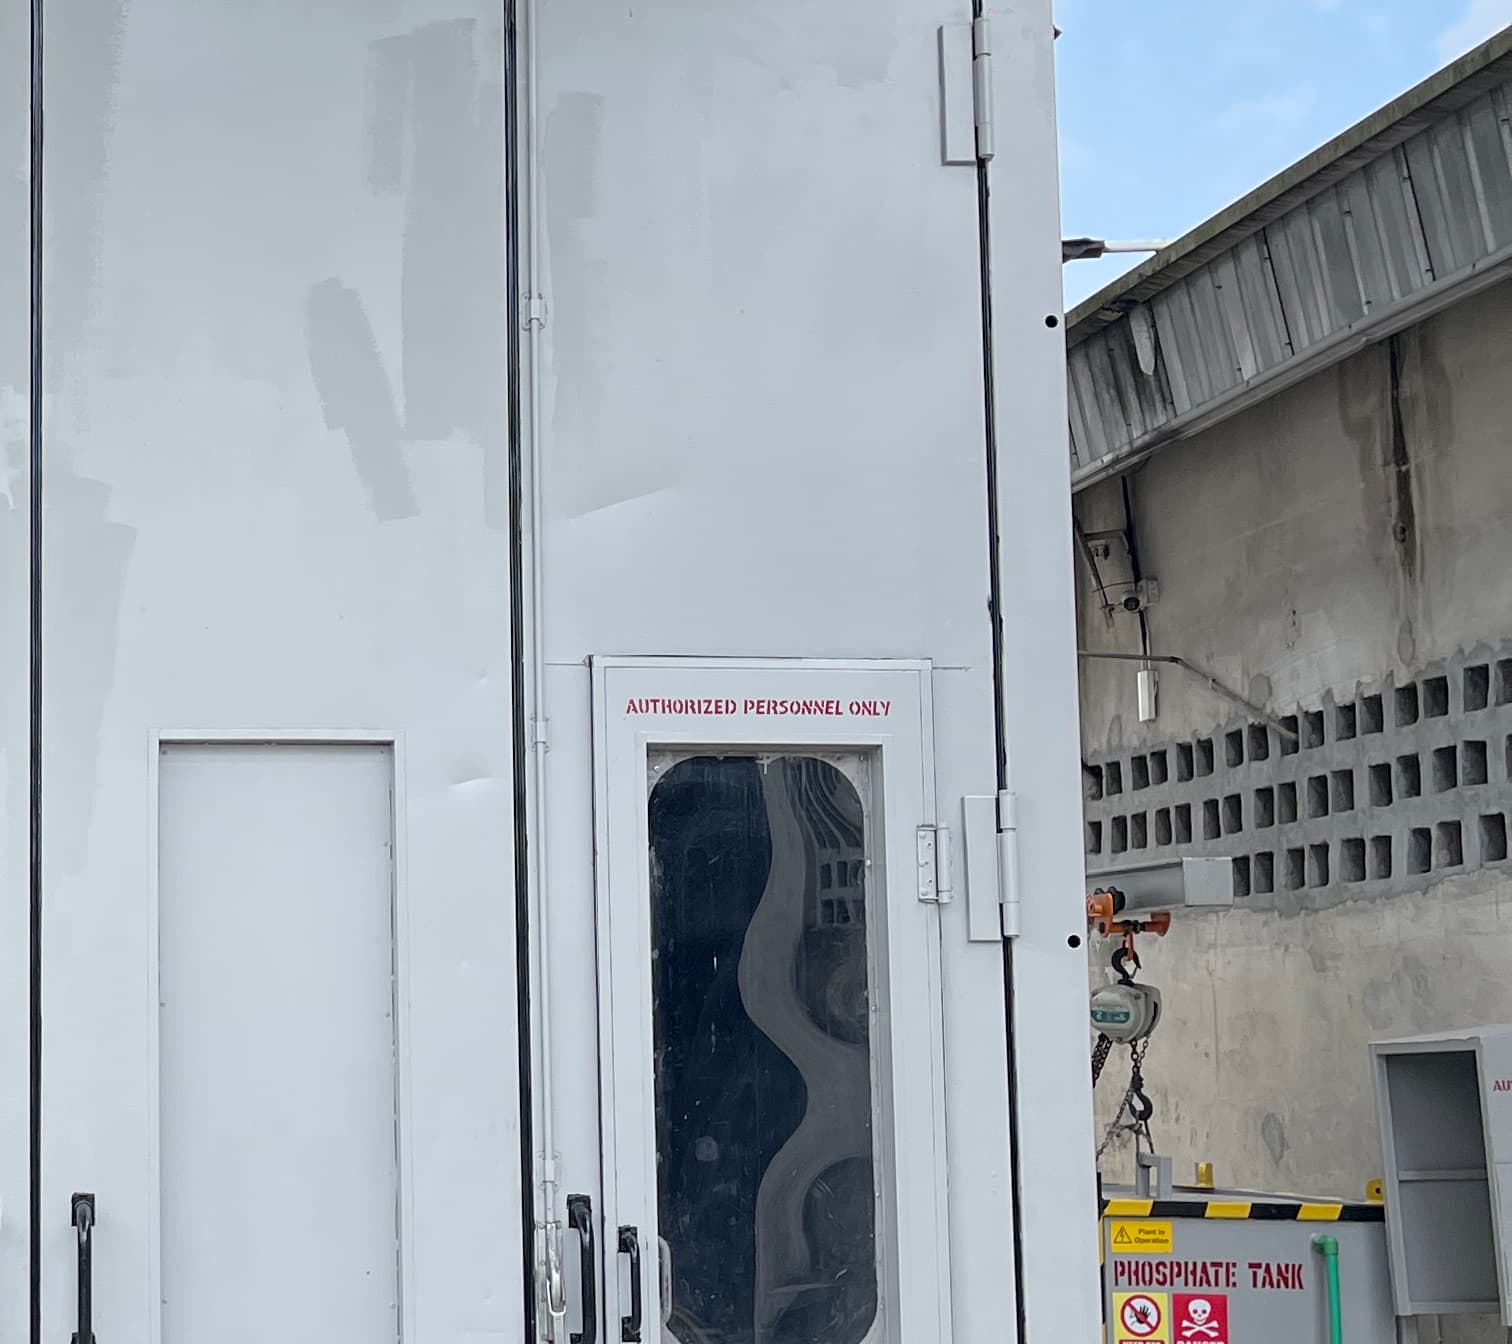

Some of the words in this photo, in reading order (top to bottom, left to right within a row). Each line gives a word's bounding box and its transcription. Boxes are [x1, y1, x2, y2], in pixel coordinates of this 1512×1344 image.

[626, 698, 737, 715] AUTHORIZED
[743, 699, 843, 716] PERSONNEL
[849, 701, 890, 716] ONLY
[1493, 1079, 1512, 1092] AU
[1114, 1260, 1237, 1288] PHOSPHATE
[1248, 1262, 1304, 1290] TANK
